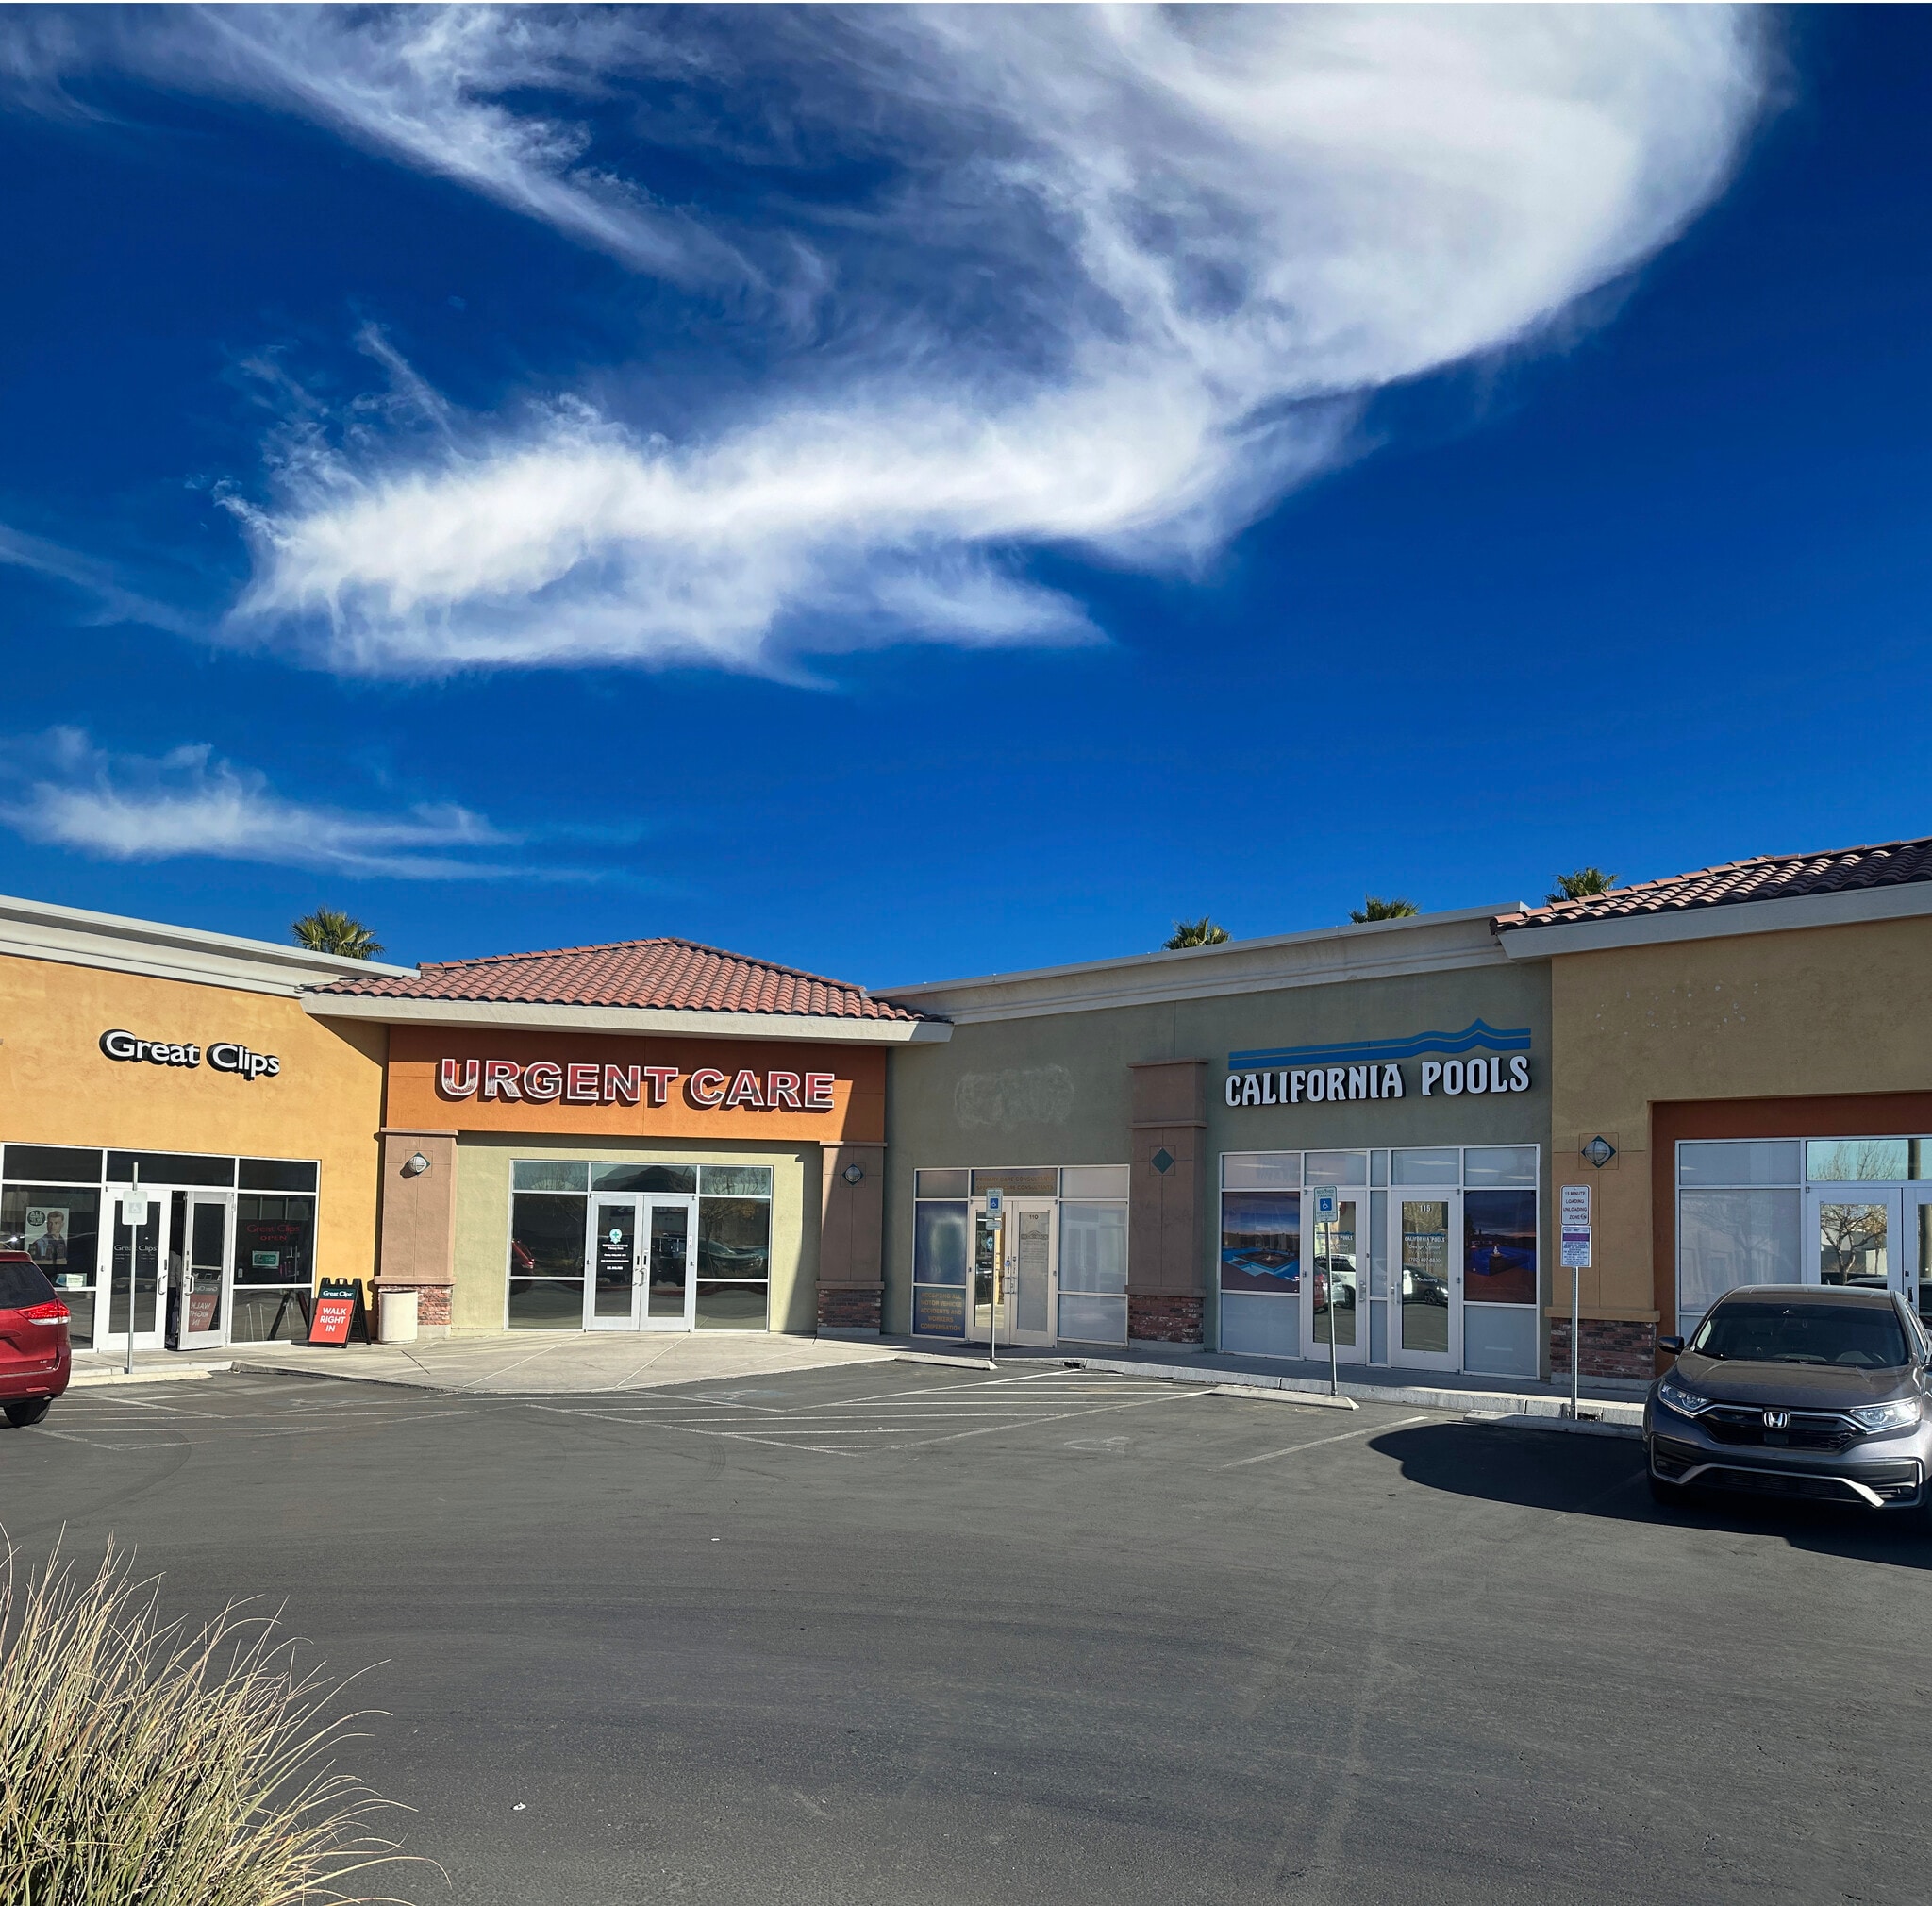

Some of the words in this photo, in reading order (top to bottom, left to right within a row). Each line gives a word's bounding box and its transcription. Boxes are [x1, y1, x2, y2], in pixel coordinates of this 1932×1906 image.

[101, 1029, 201, 1067] Great
[208, 1043, 281, 1080] Clips
[439, 1058, 679, 1102] URGENT
[690, 1069, 836, 1110] CARE
[1225, 1063, 1404, 1107] CALIFORNIA
[1421, 1055, 1529, 1096] POOLS
[246, 1224, 274, 1232] Great
[277, 1224, 301, 1235] Clips
[138, 1245, 158, 1253] Clips
[323, 1307, 347, 1315] WALK
[320, 1315, 346, 1324] RIGHT
[325, 1324, 336, 1332] IN
